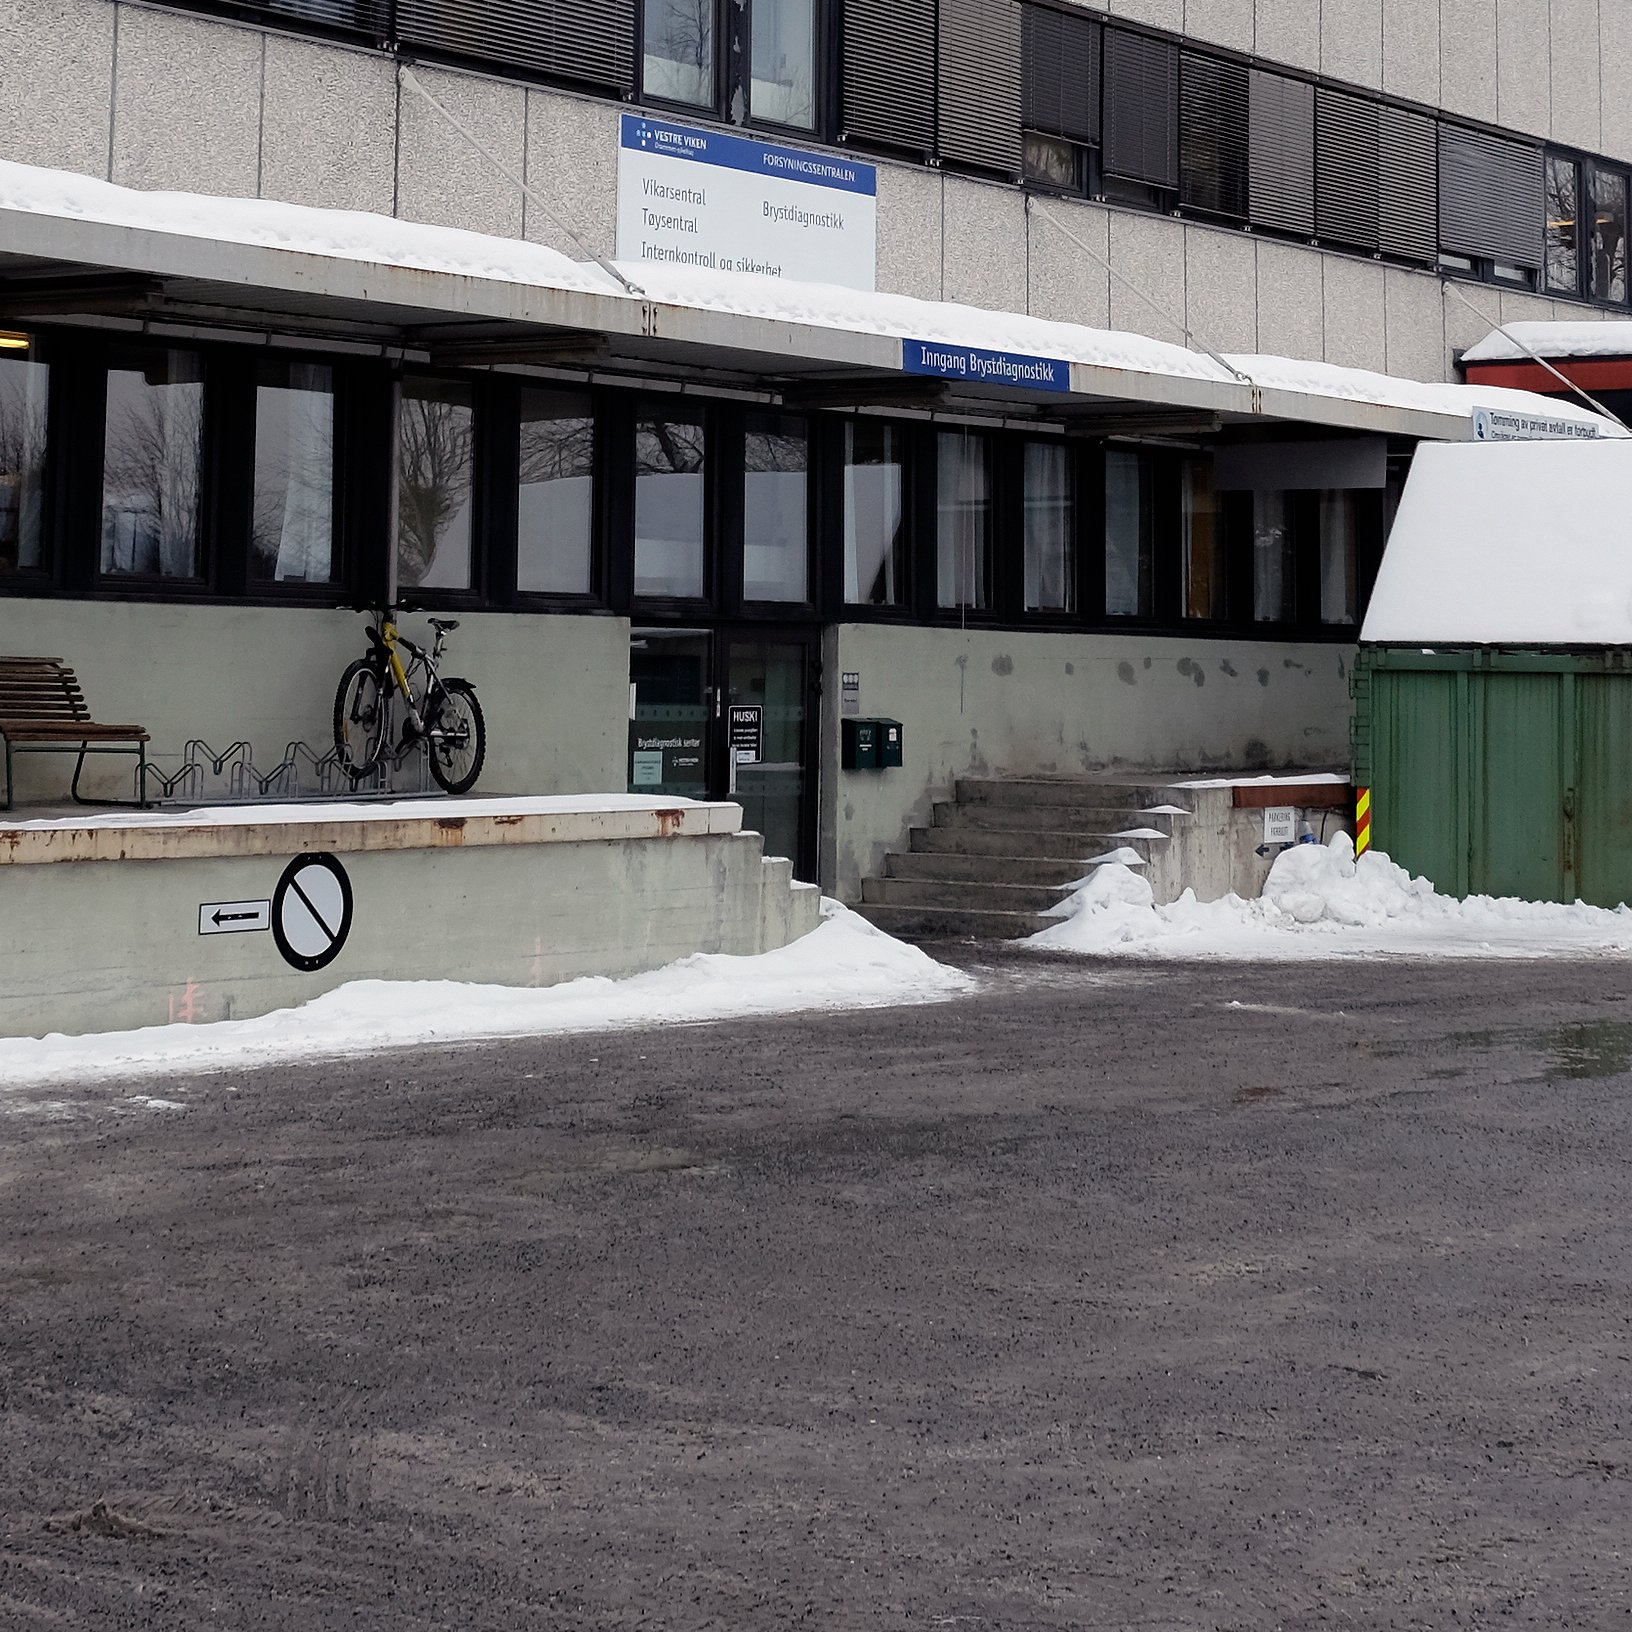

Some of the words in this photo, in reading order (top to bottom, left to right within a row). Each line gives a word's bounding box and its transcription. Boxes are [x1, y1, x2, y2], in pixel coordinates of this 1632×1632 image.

[654, 129, 683, 146] VESTRE
[683, 135, 707, 150] VIKEN
[763, 153, 856, 182] FORSYNINGSSENTRALEN
[642, 178, 707, 206] Vikarsentral
[642, 207, 699, 234] Tøysentral
[762, 200, 845, 231] Brystdiagnostikk
[640, 241, 717, 270] Internkontroll
[920, 346, 967, 375] Inngang
[969, 353, 1055, 382] Brystdiagnostikk
